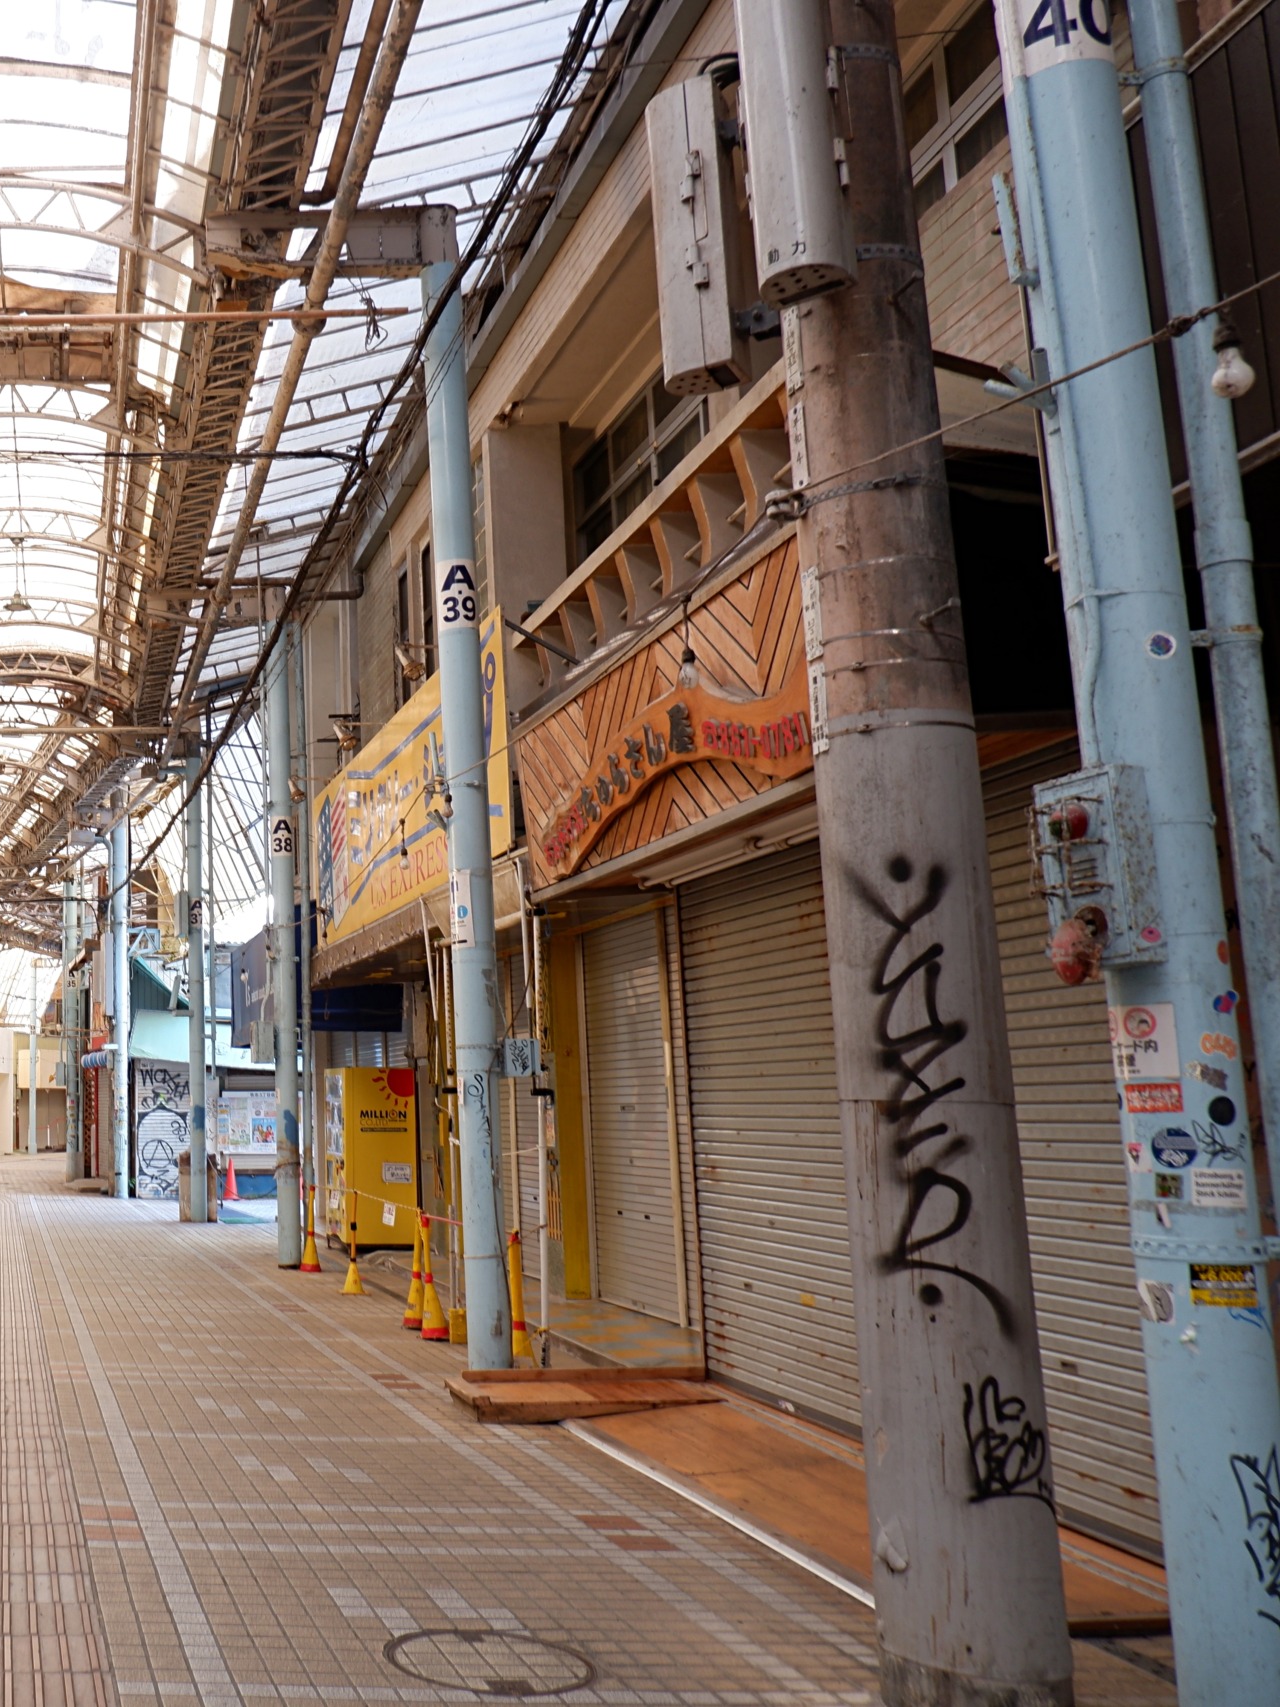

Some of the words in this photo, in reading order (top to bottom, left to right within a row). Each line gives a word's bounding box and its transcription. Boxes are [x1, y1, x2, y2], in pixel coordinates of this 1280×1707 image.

[767, 240, 806, 265] 動力
[441, 563, 476, 592] A
[442, 595, 477, 623] 39
[273, 819, 292, 834] A
[273, 837, 292, 852] 38
[67, 980, 77, 988] 35
[360, 1109, 407, 1119] MILLION
